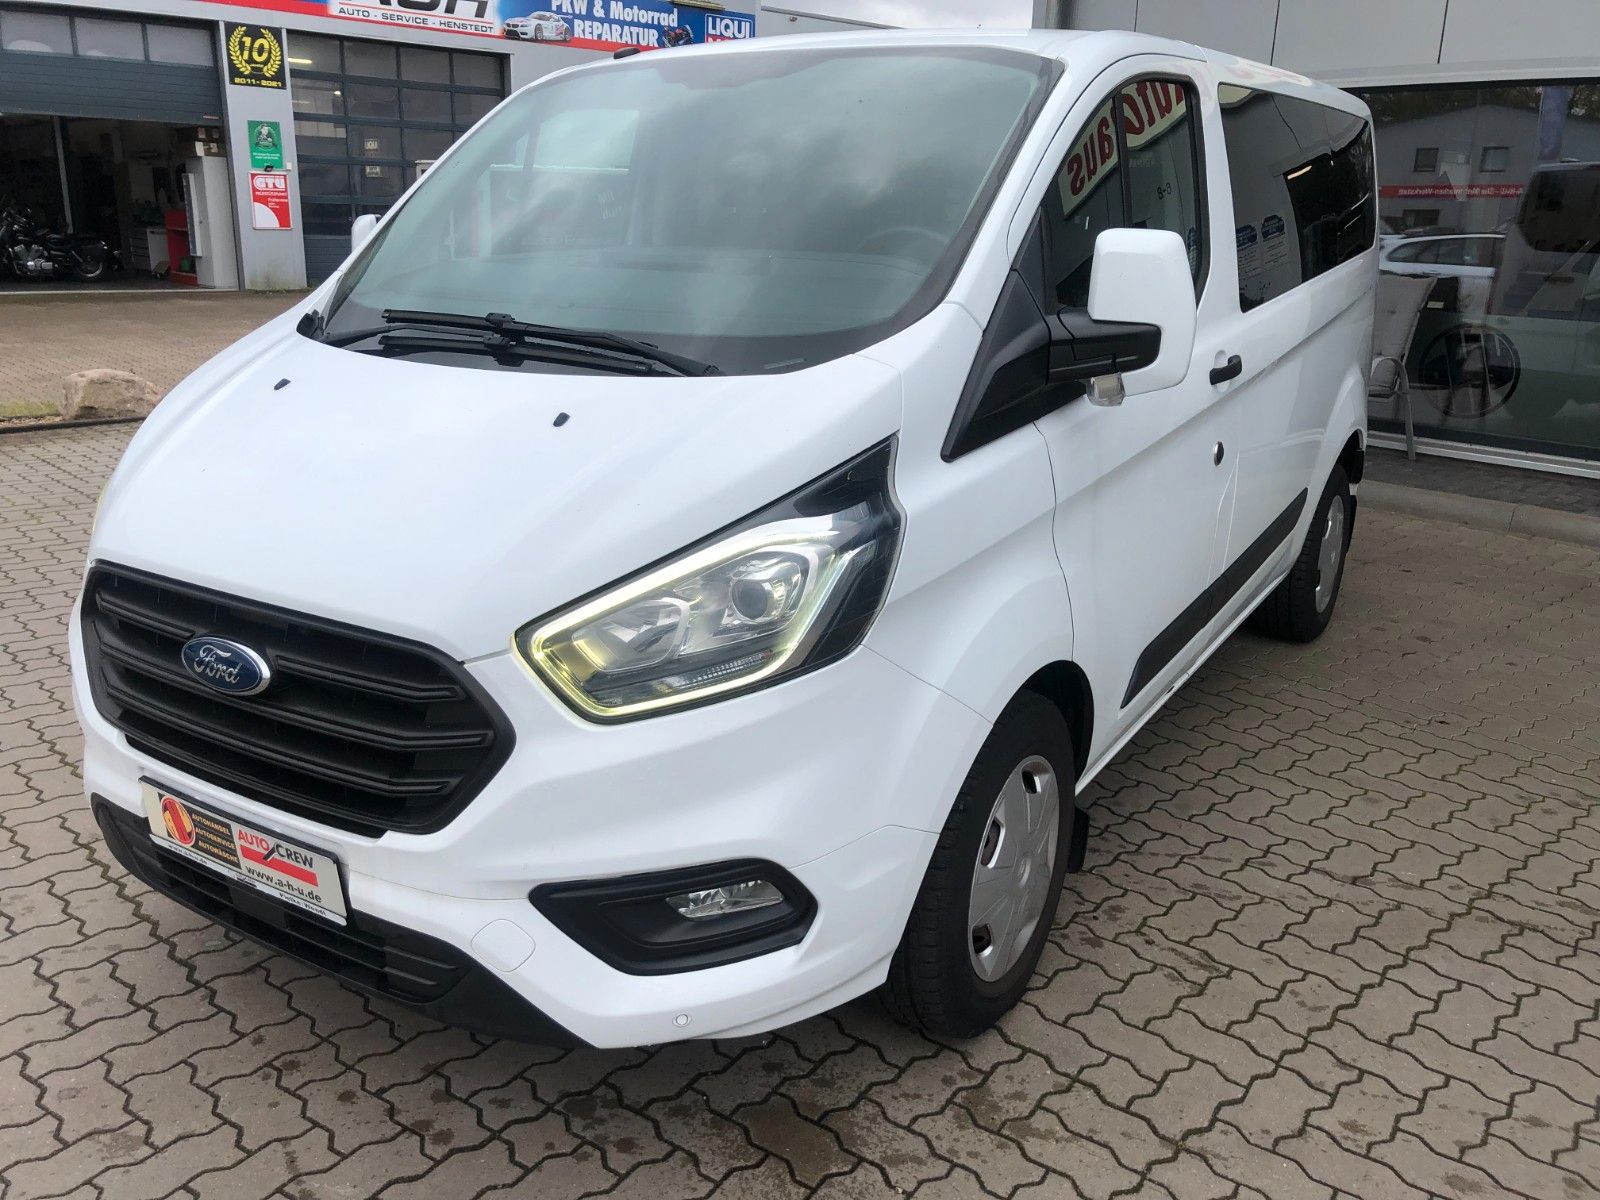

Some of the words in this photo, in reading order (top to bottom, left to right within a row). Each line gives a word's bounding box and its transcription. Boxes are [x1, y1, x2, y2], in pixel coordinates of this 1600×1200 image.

[338, 7, 370, 17] AUTO
[381, 12, 428, 25] SERVICE
[439, 20, 494, 33] HENSTEDT
[552, 0, 588, 15] PKW
[592, 0, 606, 18] &
[610, 2, 678, 27] Motorrad
[708, 16, 750, 39] LIQUI
[574, 18, 658, 47] REPARATUR
[242, 36, 270, 62] 10
[193, 644, 242, 684] Ford
[238, 829, 270, 852] AUTO
[275, 843, 314, 869] CREW
[245, 865, 322, 903] www.a-h-u.de
